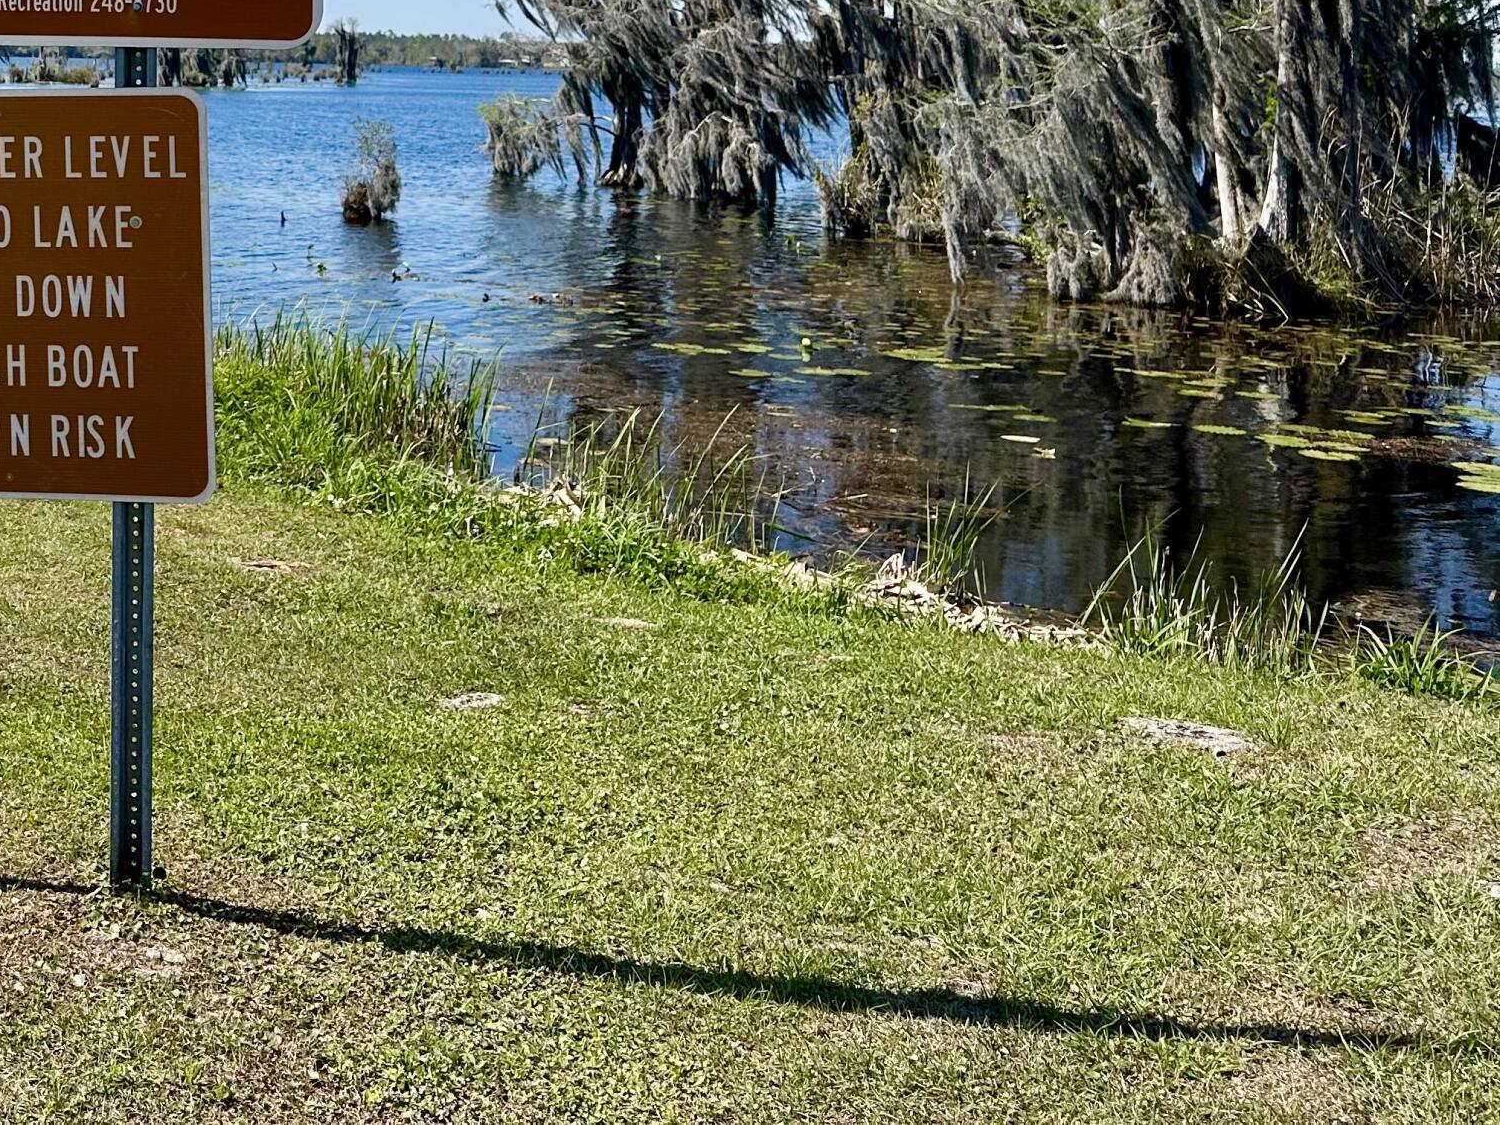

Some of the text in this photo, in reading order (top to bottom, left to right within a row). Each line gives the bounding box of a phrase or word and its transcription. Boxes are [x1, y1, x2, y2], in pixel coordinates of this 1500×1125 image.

[65, 136, 186, 177] LEVEL
[34, 206, 132, 247] LAKE
[16, 275, 124, 317] DOWN
[48, 345, 138, 388] BOAT
[52, 415, 135, 458] RISK
